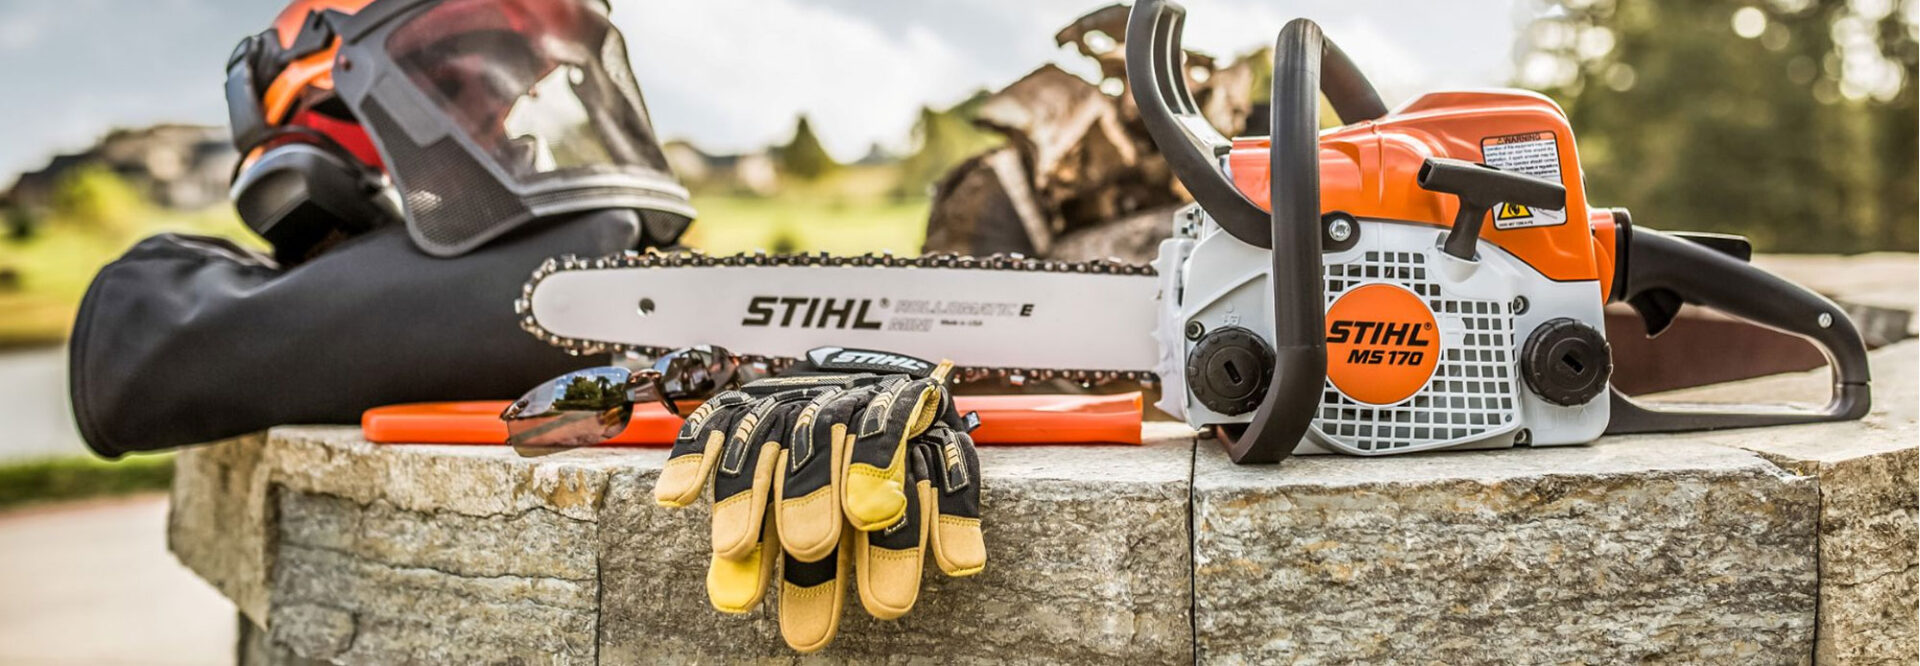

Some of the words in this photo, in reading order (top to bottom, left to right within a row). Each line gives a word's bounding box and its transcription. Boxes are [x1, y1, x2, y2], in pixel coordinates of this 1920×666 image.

[1503, 134, 1541, 144] WARNING
[741, 296, 882, 330] STIHL
[1019, 303, 1034, 317] E
[1326, 320, 1429, 347] STIHL
[831, 351, 919, 371] STIHL
[1347, 349, 1385, 365] MS
[1388, 350, 1424, 366] 170
